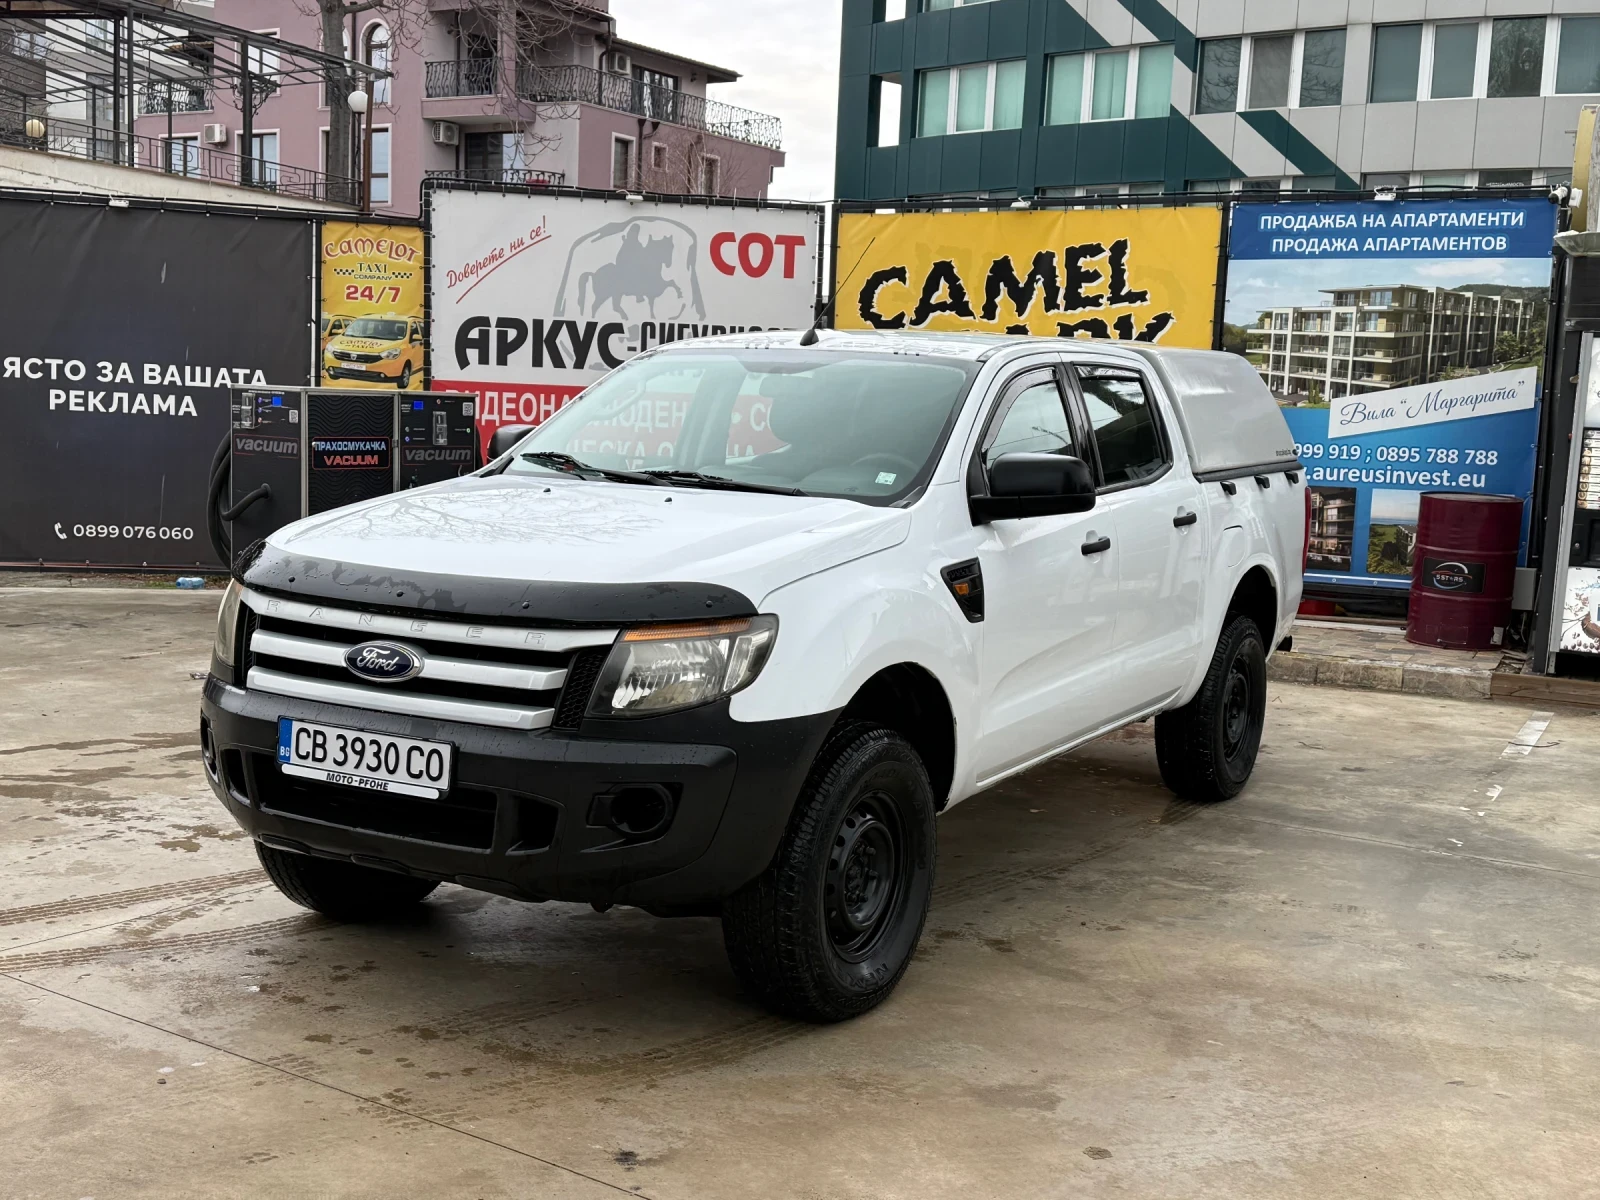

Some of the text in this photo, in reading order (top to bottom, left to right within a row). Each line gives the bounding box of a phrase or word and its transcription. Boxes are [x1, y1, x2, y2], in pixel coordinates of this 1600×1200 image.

[1260, 211, 1525, 232] ПРОДАЖБА НА АПАРТАМЕНТИ
[324, 237, 422, 263] CAMELOT
[446, 214, 547, 289] Доверете ни се!
[709, 231, 807, 279] СОТ
[1271, 236, 1508, 255] ПРОДАЖА АПАРТАМЕНТОВ
[353, 273, 393, 281] COMPANY
[357, 262, 388, 274] TAXI
[345, 284, 402, 304] 24/7
[857, 237, 1150, 330] CAMEL
[2, 356, 268, 388] ЯСТО ЗА ВАШАТА
[49, 388, 198, 417] РЕКЛАМА
[1340, 402, 1396, 425] Вила
[236, 438, 298, 454] vacuum
[314, 441, 387, 451] ПРАХОСМУКАЧКА
[404, 449, 471, 461] vacuum
[1328, 444, 1361, 460] 919
[1376, 446, 1421, 462] 0895
[1426, 448, 1459, 464] 788
[1464, 450, 1498, 466] 788
[323, 454, 379, 466] VACUUM
[266, 599, 547, 648] RANGER
[356, 646, 400, 672] Ford
[280, 745, 290, 757] BG
[295, 727, 444, 782] CB 3930 CO
[326, 772, 389, 791] MOTO-PFOHE
